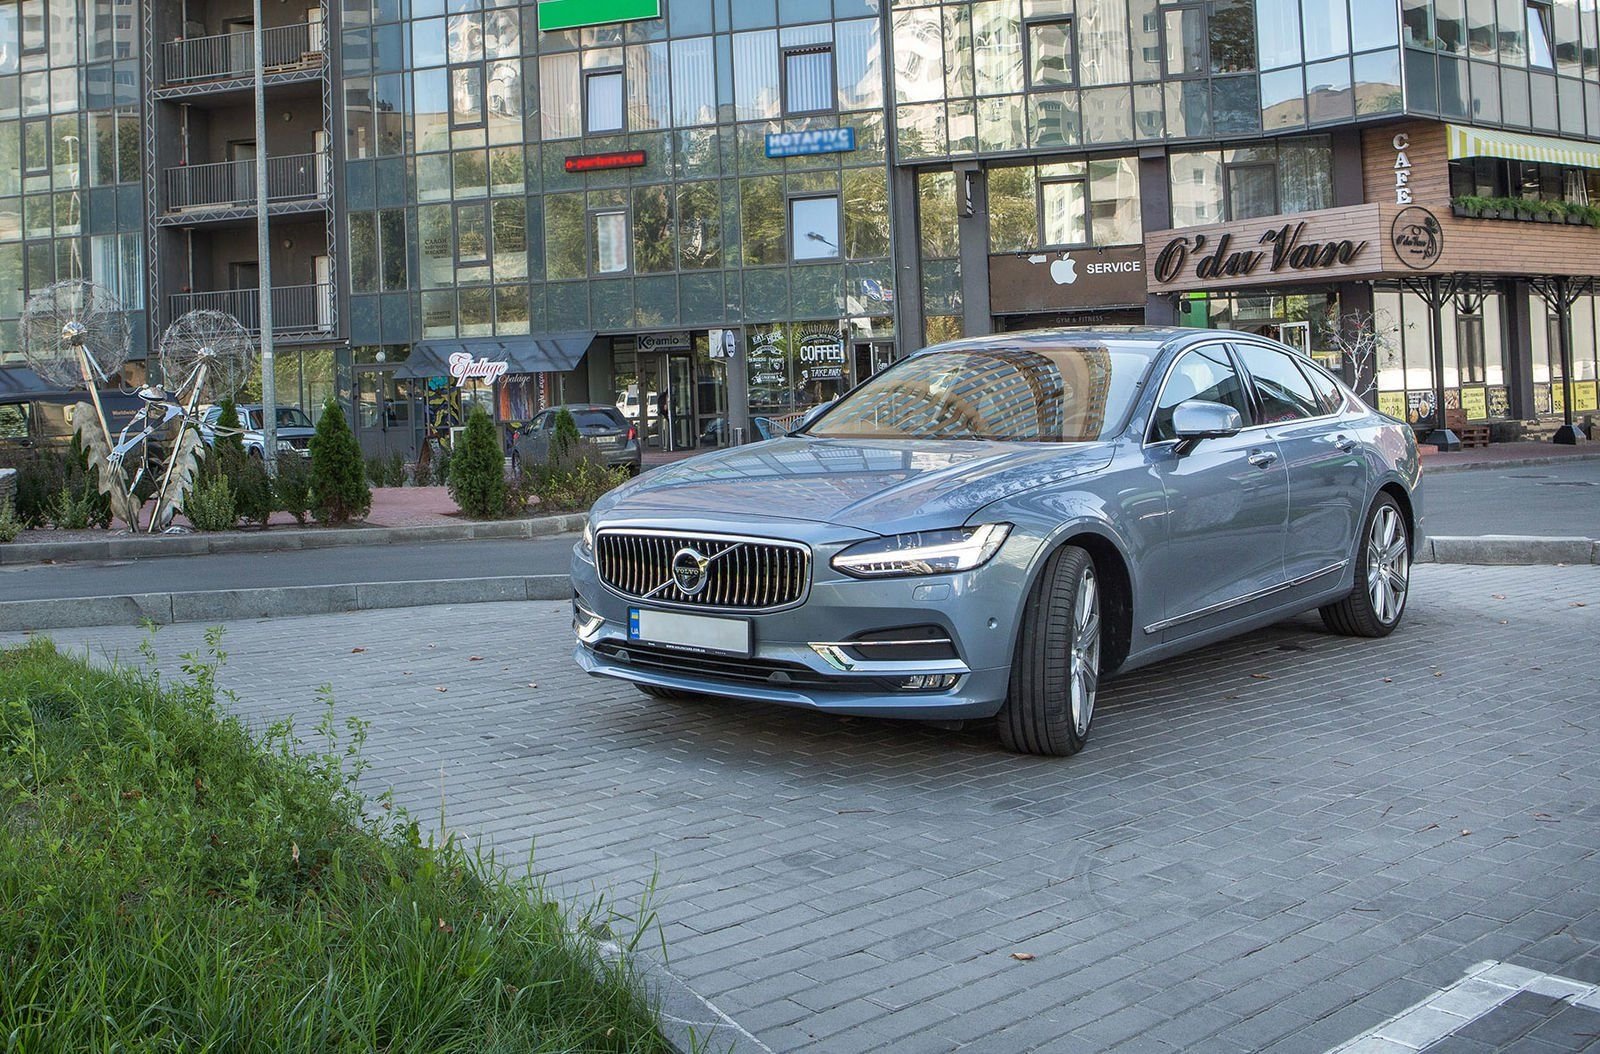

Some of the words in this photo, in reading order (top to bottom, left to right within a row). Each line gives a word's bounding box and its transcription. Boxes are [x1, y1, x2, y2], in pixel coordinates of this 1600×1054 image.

[1392, 133, 1412, 205] CAFE
[1258, 221, 1368, 273] Van
[1086, 261, 1141, 274] SERVICE
[1079, 315, 1104, 323] FITNESS
[449, 352, 509, 387] Epalage
[811, 369, 828, 377] TAKE
[675, 567, 699, 575] VOLVO
